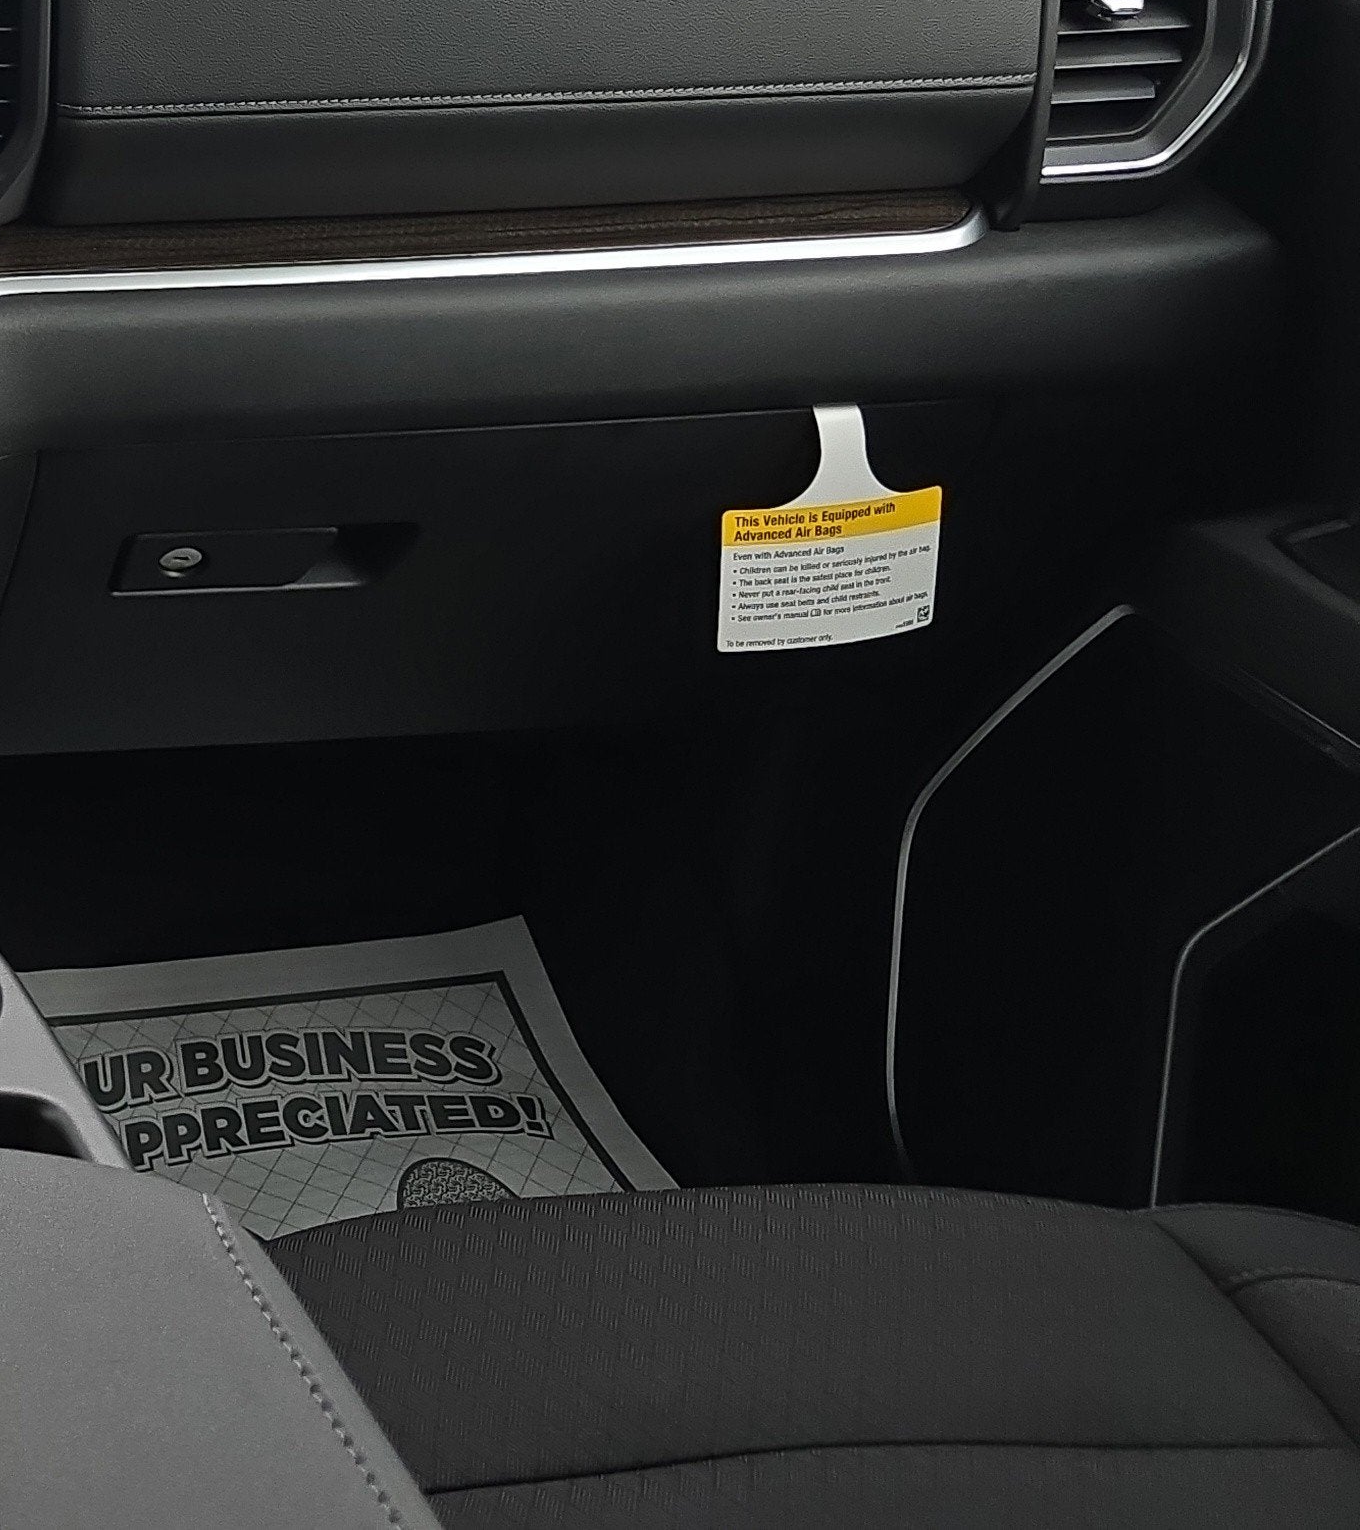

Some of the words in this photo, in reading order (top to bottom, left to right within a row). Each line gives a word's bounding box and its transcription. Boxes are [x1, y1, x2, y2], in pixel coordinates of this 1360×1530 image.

[735, 516, 759, 528] This
[763, 514, 805, 526] Vehicle
[808, 511, 818, 523] is
[821, 506, 871, 523] Equipped
[873, 501, 896, 516] with
[733, 528, 792, 542] Advanced
[795, 527, 811, 538] Air
[815, 524, 842, 538] Bags
[733, 551, 752, 562] Even
[754, 550, 772, 560] with
[773, 547, 812, 559] Advanced
[813, 546, 824, 556] Air
[826, 545, 845, 556] Bags
[739, 566, 772, 575] Children
[773, 565, 787, 573] can
[800, 562, 821, 571] killed
[832, 557, 863, 568] seriously
[864, 553, 888, 564] injured
[739, 578, 753, 587] The
[754, 577, 772, 586] back
[774, 576, 789, 585] seat
[799, 574, 810, 583] the
[812, 572, 834, 582] safest
[834, 571, 853, 581] place
[738, 591, 761, 599] Never
[762, 590, 774, 598] put
[782, 586, 821, 597] rear-facing
[822, 583, 839, 592] child
[840, 582, 855, 591] seat
[737, 602, 764, 611] Always
[766, 601, 779, 609] use
[780, 600, 796, 608] seat
[797, 598, 815, 607] belts
[816, 597, 830, 605] and
[831, 594, 848, 603] child
[737, 614, 751, 623] See
[753, 612, 782, 622] owner's
[783, 609, 809, 620] manual
[834, 606, 851, 615] more
[852, 601, 888, 613] information
[888, 597, 905, 607] about
[746, 638, 776, 647] removed
[786, 634, 818, 645] customer
[81, 1050, 175, 1108] UR
[179, 1030, 501, 1088] BUSINESS
[123, 1091, 552, 1167] PPRECIATED!
